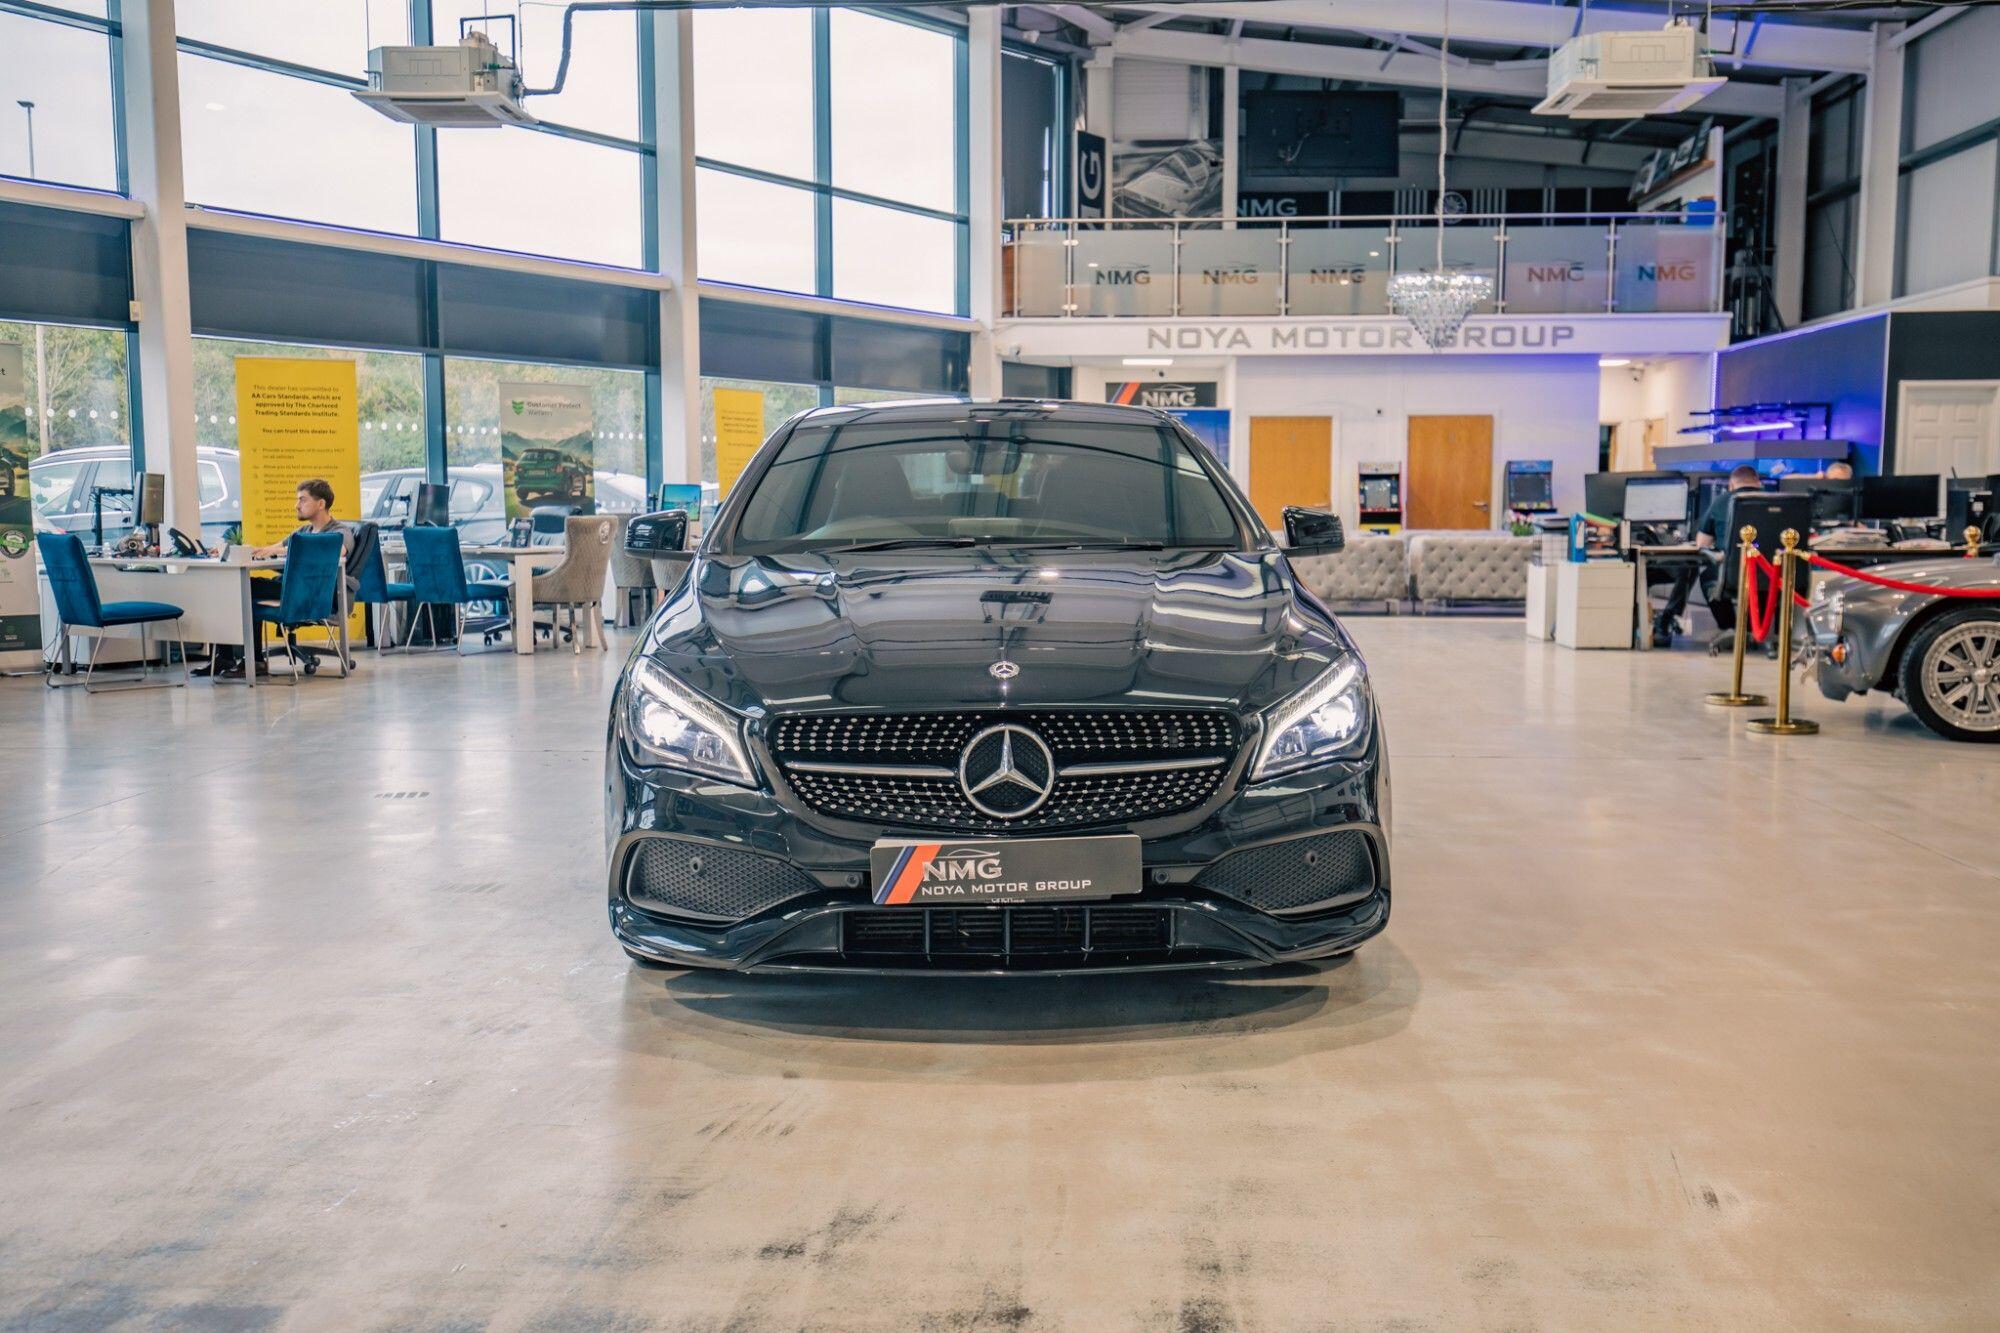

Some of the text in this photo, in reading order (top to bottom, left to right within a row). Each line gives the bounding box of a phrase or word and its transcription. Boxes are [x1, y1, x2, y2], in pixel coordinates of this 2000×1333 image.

[1096, 270, 1151, 285] NMG
[1203, 269, 1258, 284] NMG
[1638, 265, 1696, 281] NMG
[1148, 327, 1252, 349] NOYA
[1271, 326, 1413, 348] MOTOR
[1141, 391, 1196, 406] NMG
[921, 858, 1002, 883] NMG
[921, 880, 1092, 895] NOYA MOTOR GROUP
